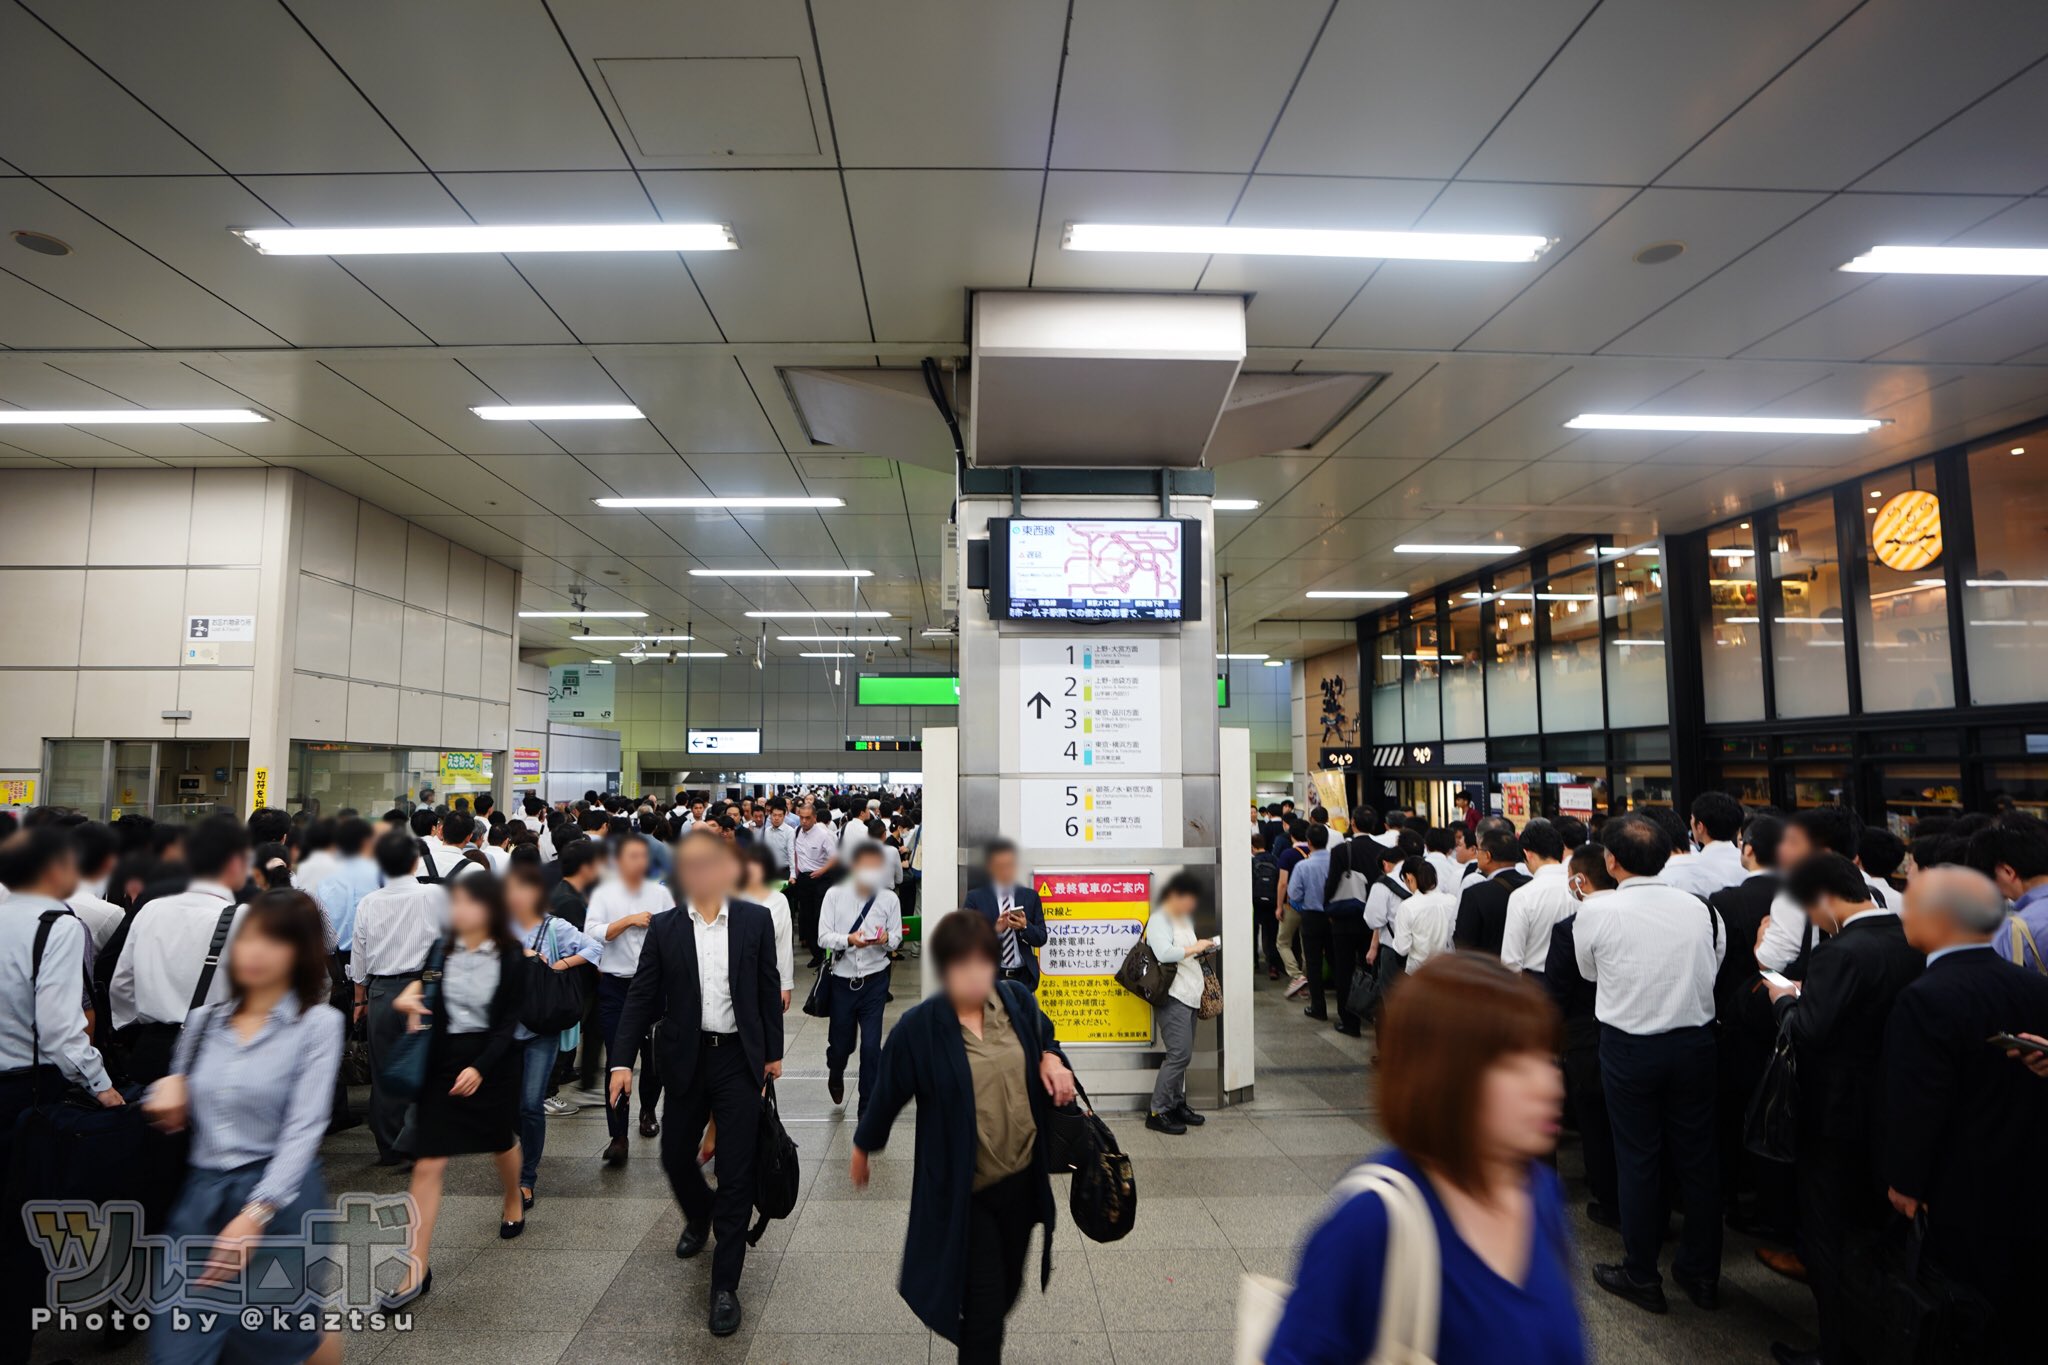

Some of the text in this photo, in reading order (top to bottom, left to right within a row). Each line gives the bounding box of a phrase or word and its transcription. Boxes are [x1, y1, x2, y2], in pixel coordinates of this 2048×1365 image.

[1023, 525, 1055, 535] 東西線
[1066, 645, 1074, 665] 1
[1064, 677, 1077, 697] 2
[1064, 709, 1077, 729] 3
[1063, 741, 1078, 761] 4
[1066, 786, 1078, 806] 5
[1065, 816, 1079, 837] 6
[1054, 882, 1145, 894] 最終電車のご案内
[1049, 937, 1095, 946] 最終電車は
[1049, 948, 1129, 957] 待ち合わせをせずに
[1049, 960, 1114, 968] 発車いたします。
